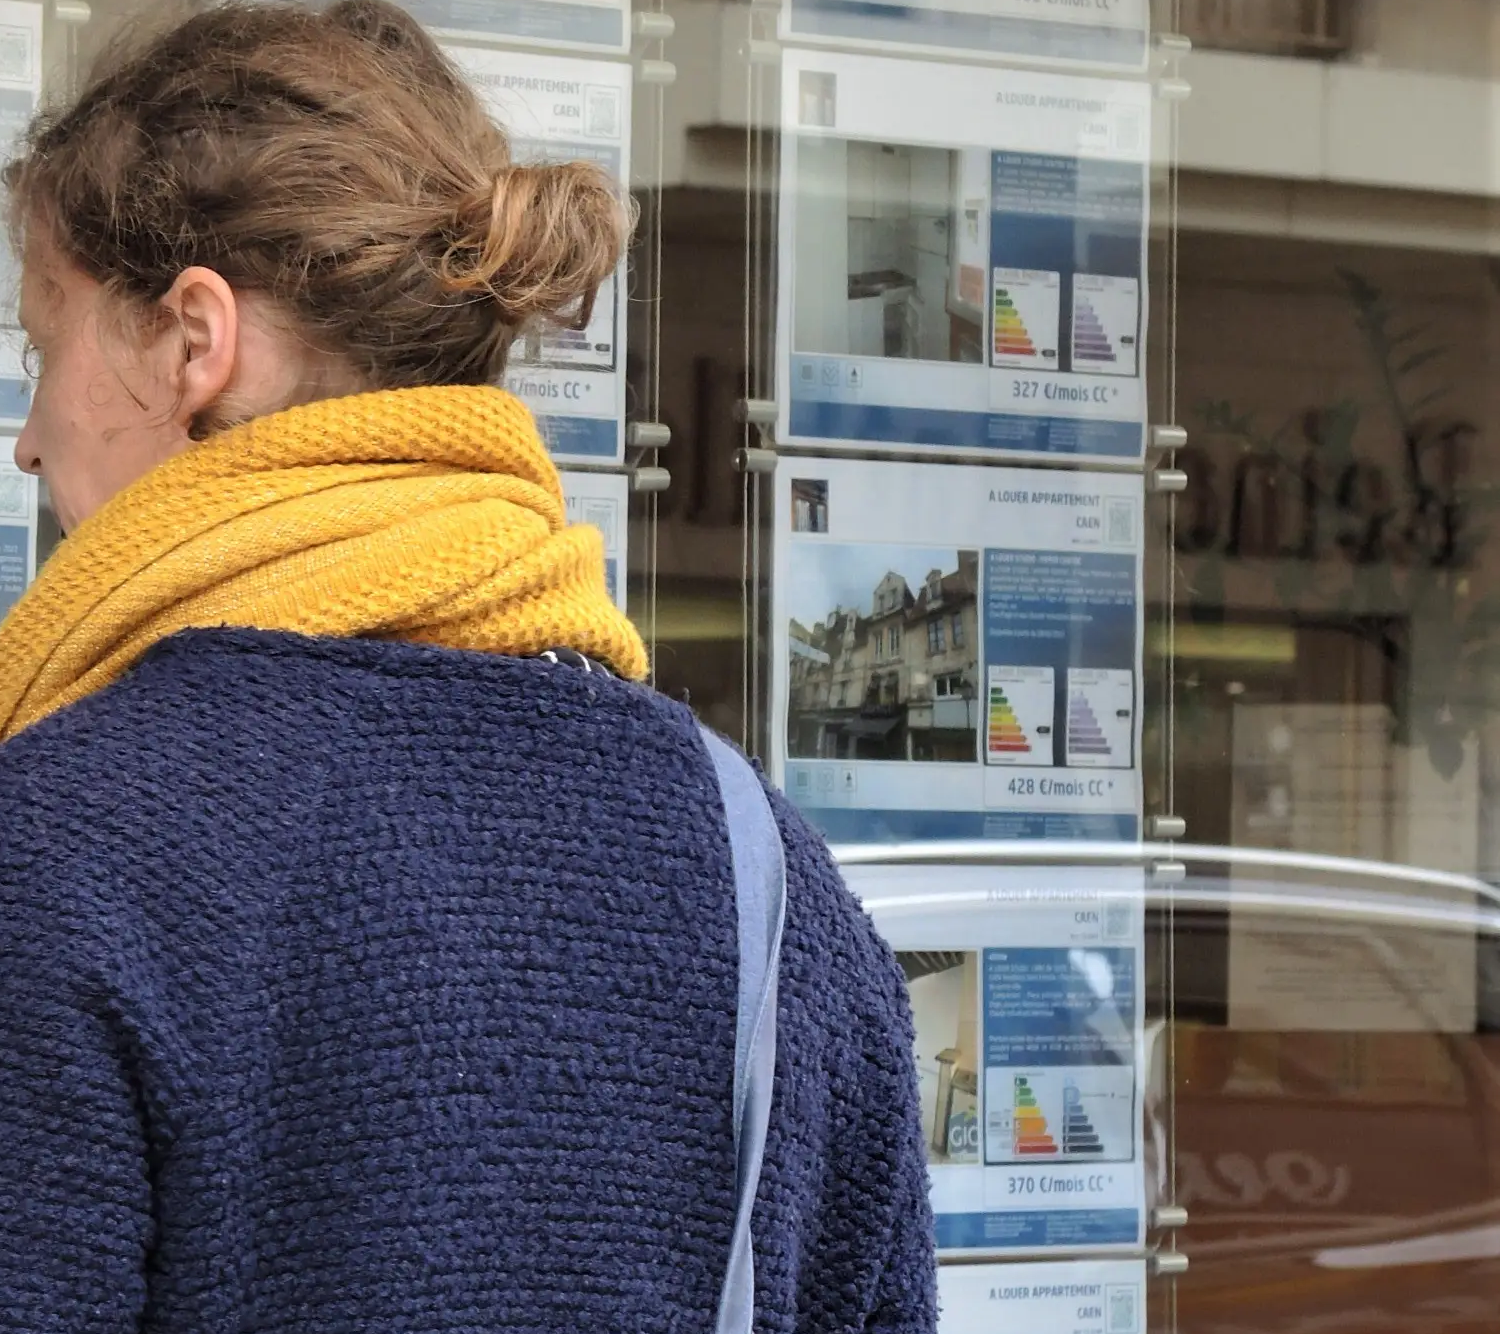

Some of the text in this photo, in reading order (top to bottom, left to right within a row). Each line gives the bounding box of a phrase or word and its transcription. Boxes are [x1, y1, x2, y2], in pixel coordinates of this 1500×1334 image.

[552, 103, 580, 119] CAEN
[564, 381, 581, 400] CC
[1012, 381, 1108, 403] 327 €/mois CC
[1008, 777, 1104, 797] 428 €/mois CC
[1008, 1175, 1104, 1194] 370 €/mois CC
[998, 1285, 1102, 1300] LOUER APPARTEMENT
